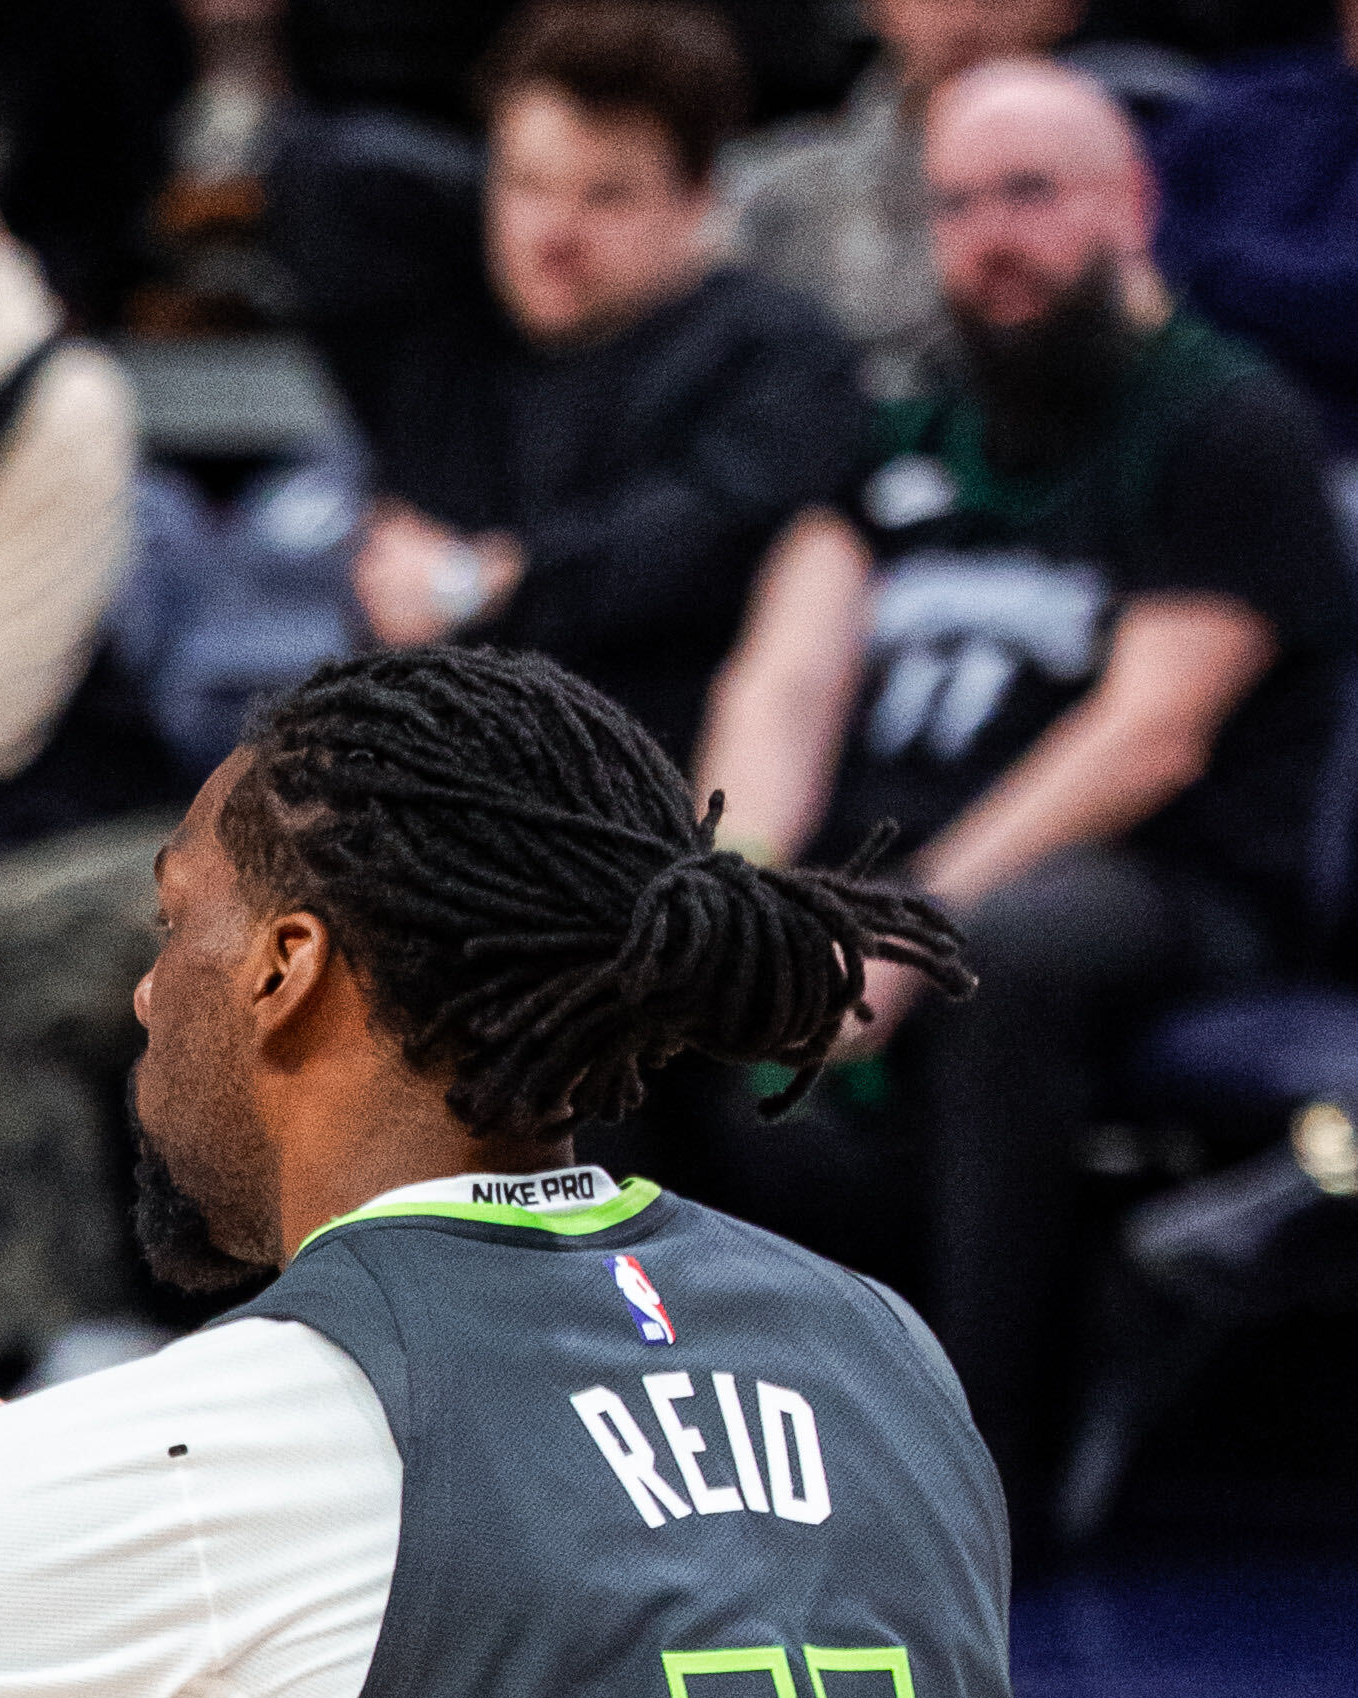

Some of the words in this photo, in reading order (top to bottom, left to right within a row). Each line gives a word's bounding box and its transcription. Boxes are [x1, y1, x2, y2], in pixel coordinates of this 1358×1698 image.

[472, 1182, 540, 1207] NIKE
[541, 1172, 595, 1203] PRO
[570, 1371, 832, 1529] REID
